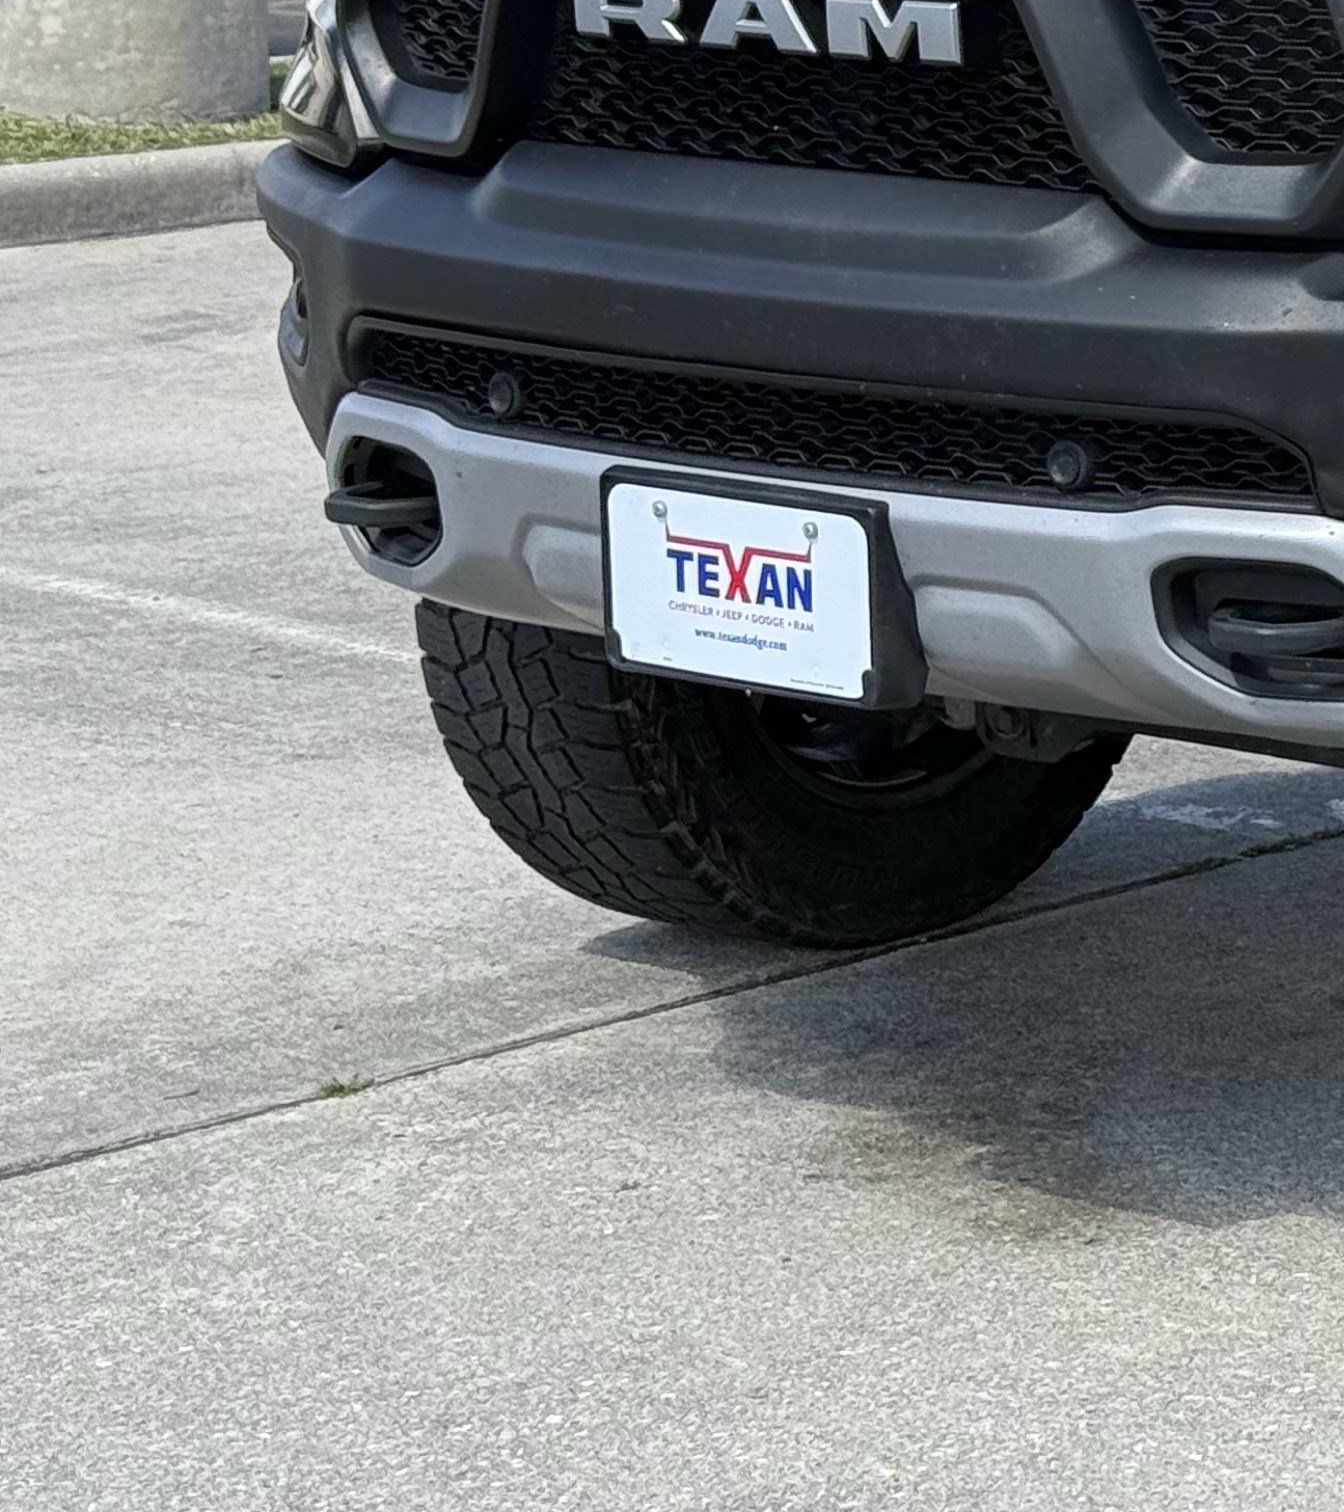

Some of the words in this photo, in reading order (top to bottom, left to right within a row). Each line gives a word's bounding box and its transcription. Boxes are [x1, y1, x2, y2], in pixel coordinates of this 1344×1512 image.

[666, 543, 814, 613] TEXAN
[668, 599, 714, 617] CHRYSLER
[721, 610, 743, 621] JEEP
[751, 614, 785, 629] DODGE
[793, 619, 815, 633] RAM
[694, 628, 788, 651] www.texandodge.com
